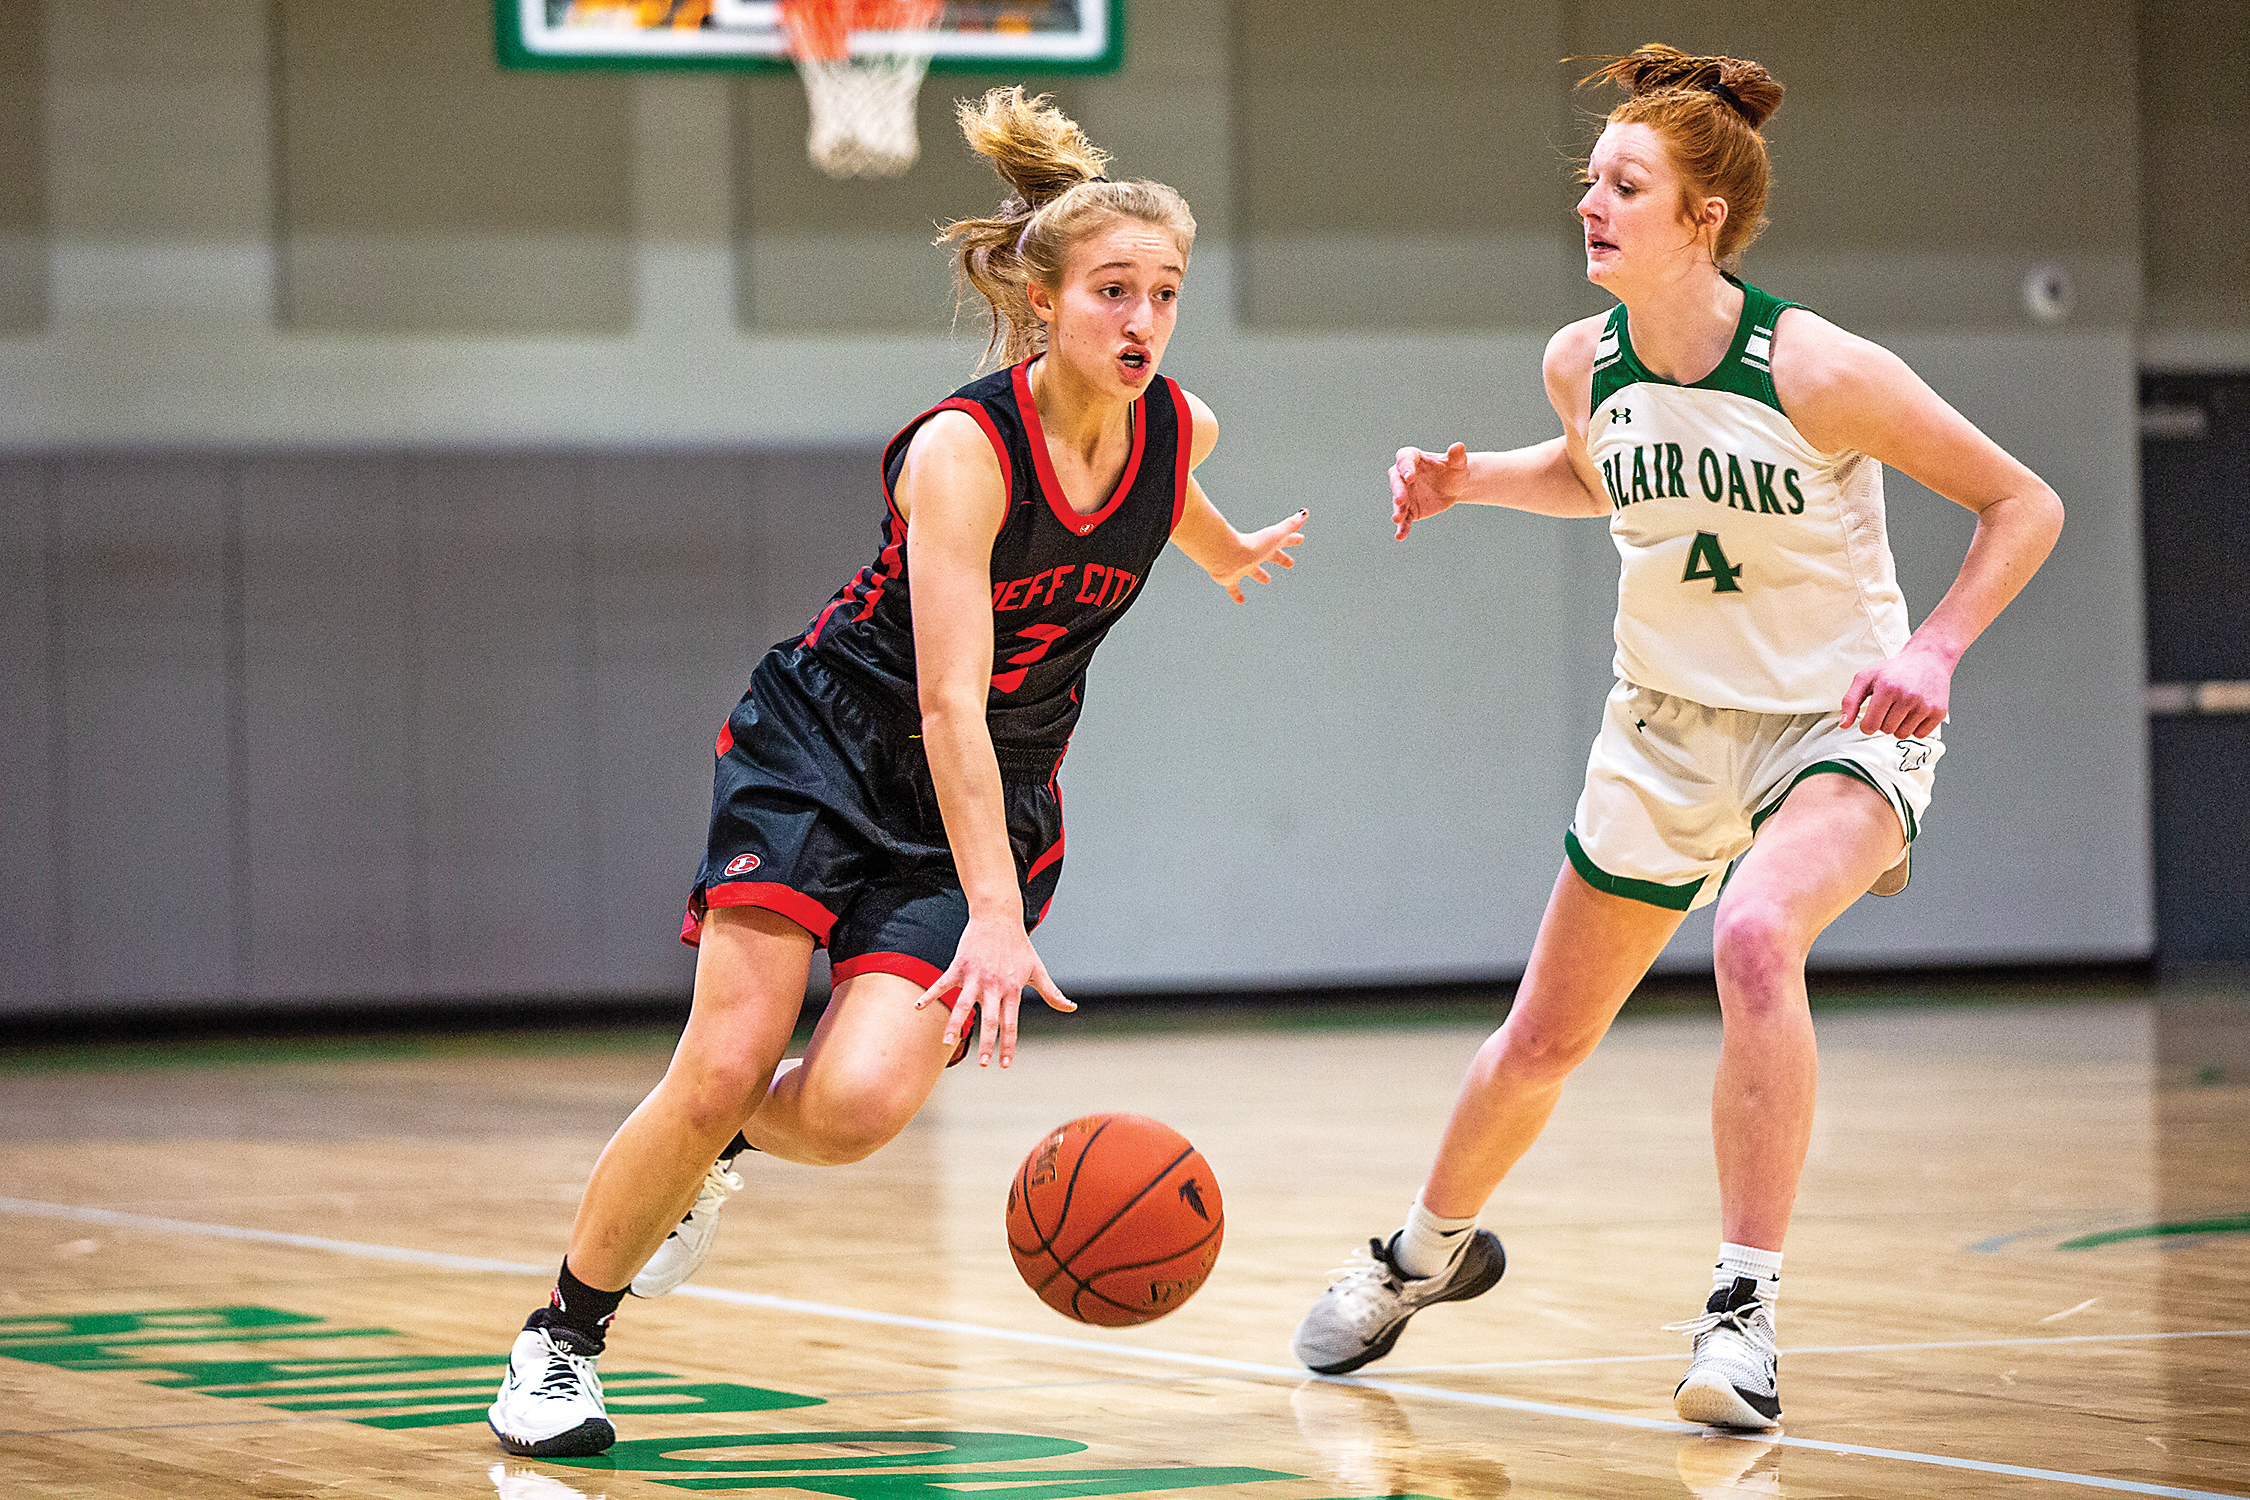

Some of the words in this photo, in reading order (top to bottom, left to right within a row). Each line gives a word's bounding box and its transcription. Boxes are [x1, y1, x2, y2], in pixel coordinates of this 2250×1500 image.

[1602, 442, 1691, 511] BLAIR
[1697, 447, 1806, 515] OAKS
[1680, 529, 1744, 594] 4
[530, 1429, 1455, 1500] OA
